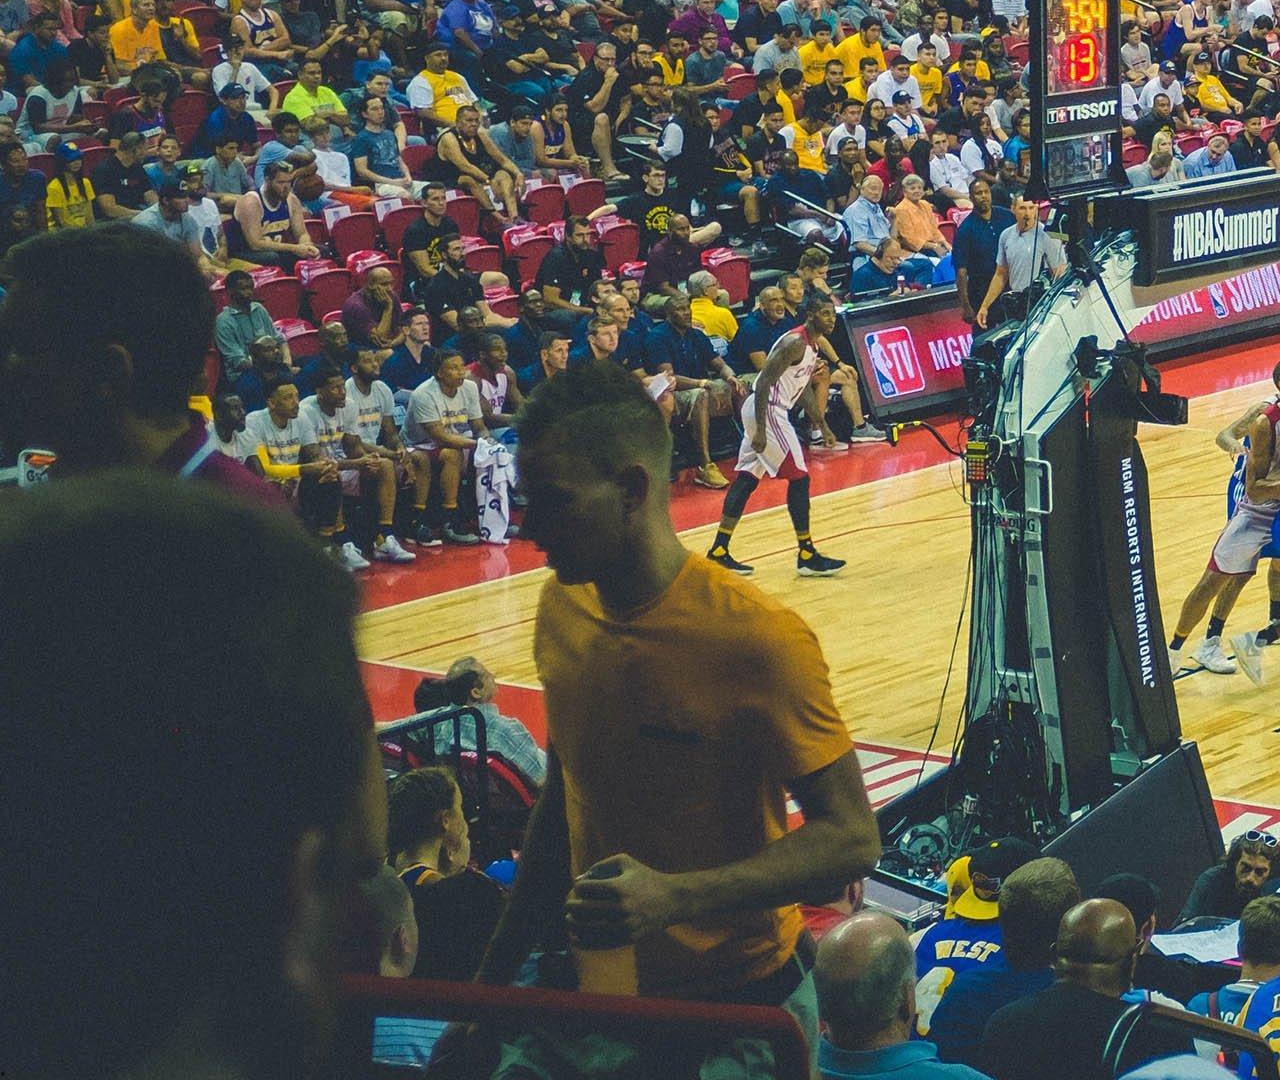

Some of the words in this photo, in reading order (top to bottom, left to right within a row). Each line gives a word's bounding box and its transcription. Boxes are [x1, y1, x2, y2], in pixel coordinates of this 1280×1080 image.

[1068, 36, 1097, 84] 13
[1068, 100, 1118, 123] TISSOT
[1173, 207, 1279, 262] #NBASummer
[886, 339, 916, 381] TV
[927, 332, 974, 371] MGM
[1120, 456, 1135, 495] MGM
[1124, 499, 1141, 565] RESORTS
[935, 939, 1001, 963] WEST
